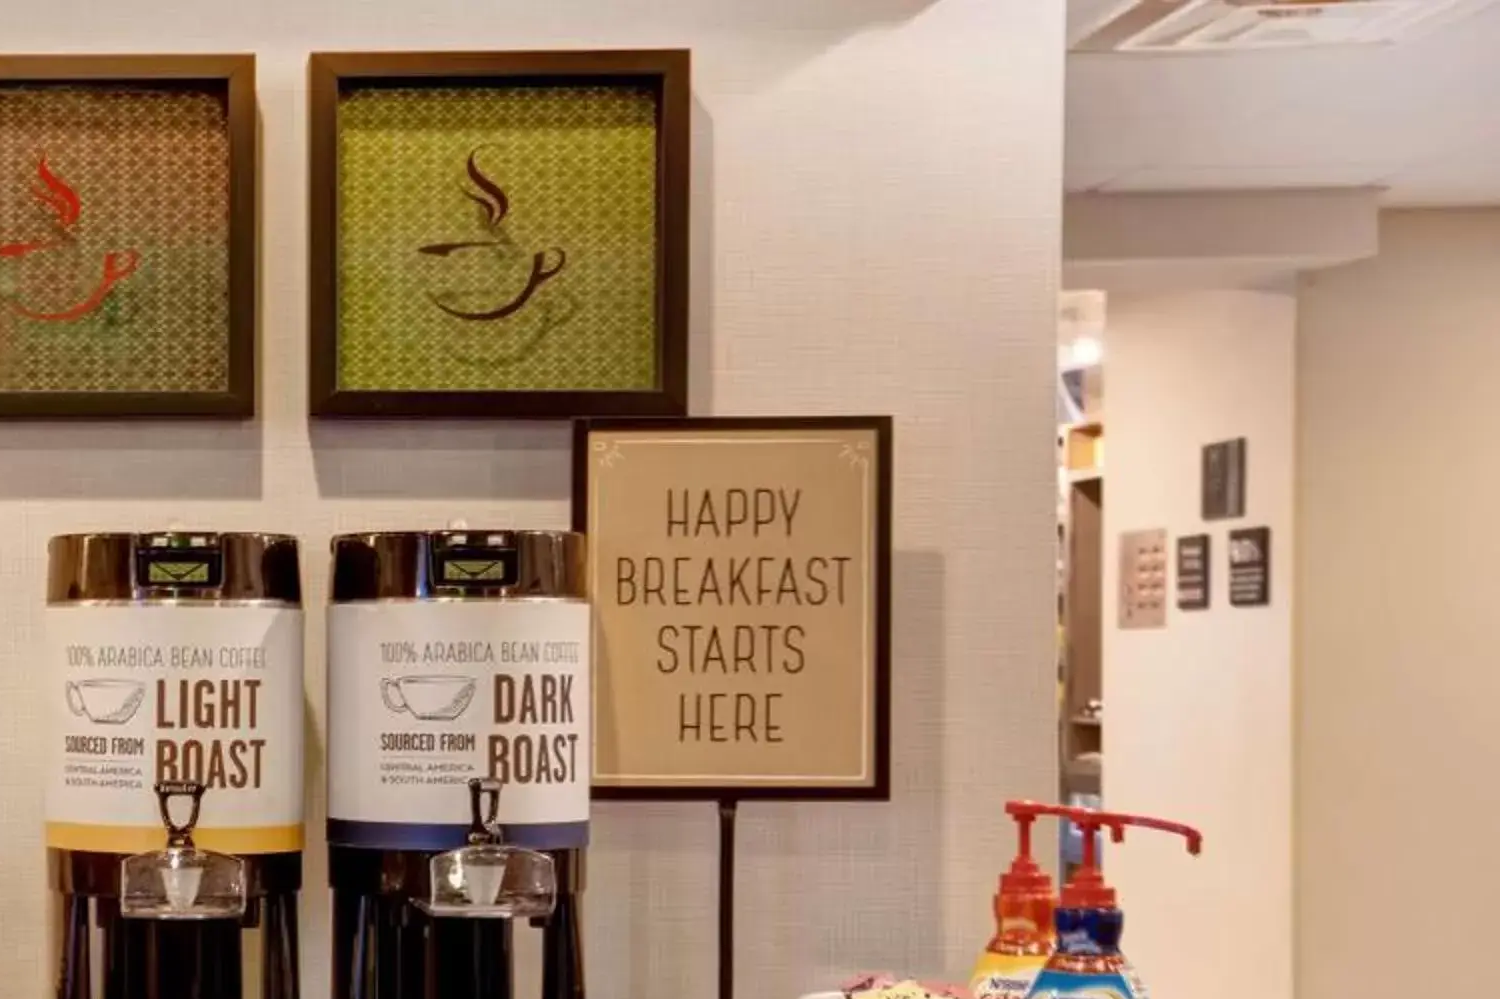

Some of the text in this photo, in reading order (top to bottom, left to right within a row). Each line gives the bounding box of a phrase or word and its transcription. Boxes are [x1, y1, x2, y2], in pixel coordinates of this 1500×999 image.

[666, 487, 803, 538] HAPPY
[615, 556, 852, 606] BREAKFAST
[97, 646, 165, 668] ARABICA
[170, 647, 214, 669] BEAN
[218, 647, 267, 670] COFFEE
[380, 641, 580, 664] 100% ARABICA BEAN COFFEE
[656, 624, 806, 674] STARTS
[155, 678, 262, 729] LIGHT
[493, 673, 574, 725] DARK
[678, 693, 784, 743] HERE
[65, 735, 145, 756] SOURCED FROM
[155, 739, 266, 789] ROAST
[380, 732, 476, 752] SOURCED FROM
[488, 734, 579, 784] ROAST
[426, 775, 470, 785] AMERIC
